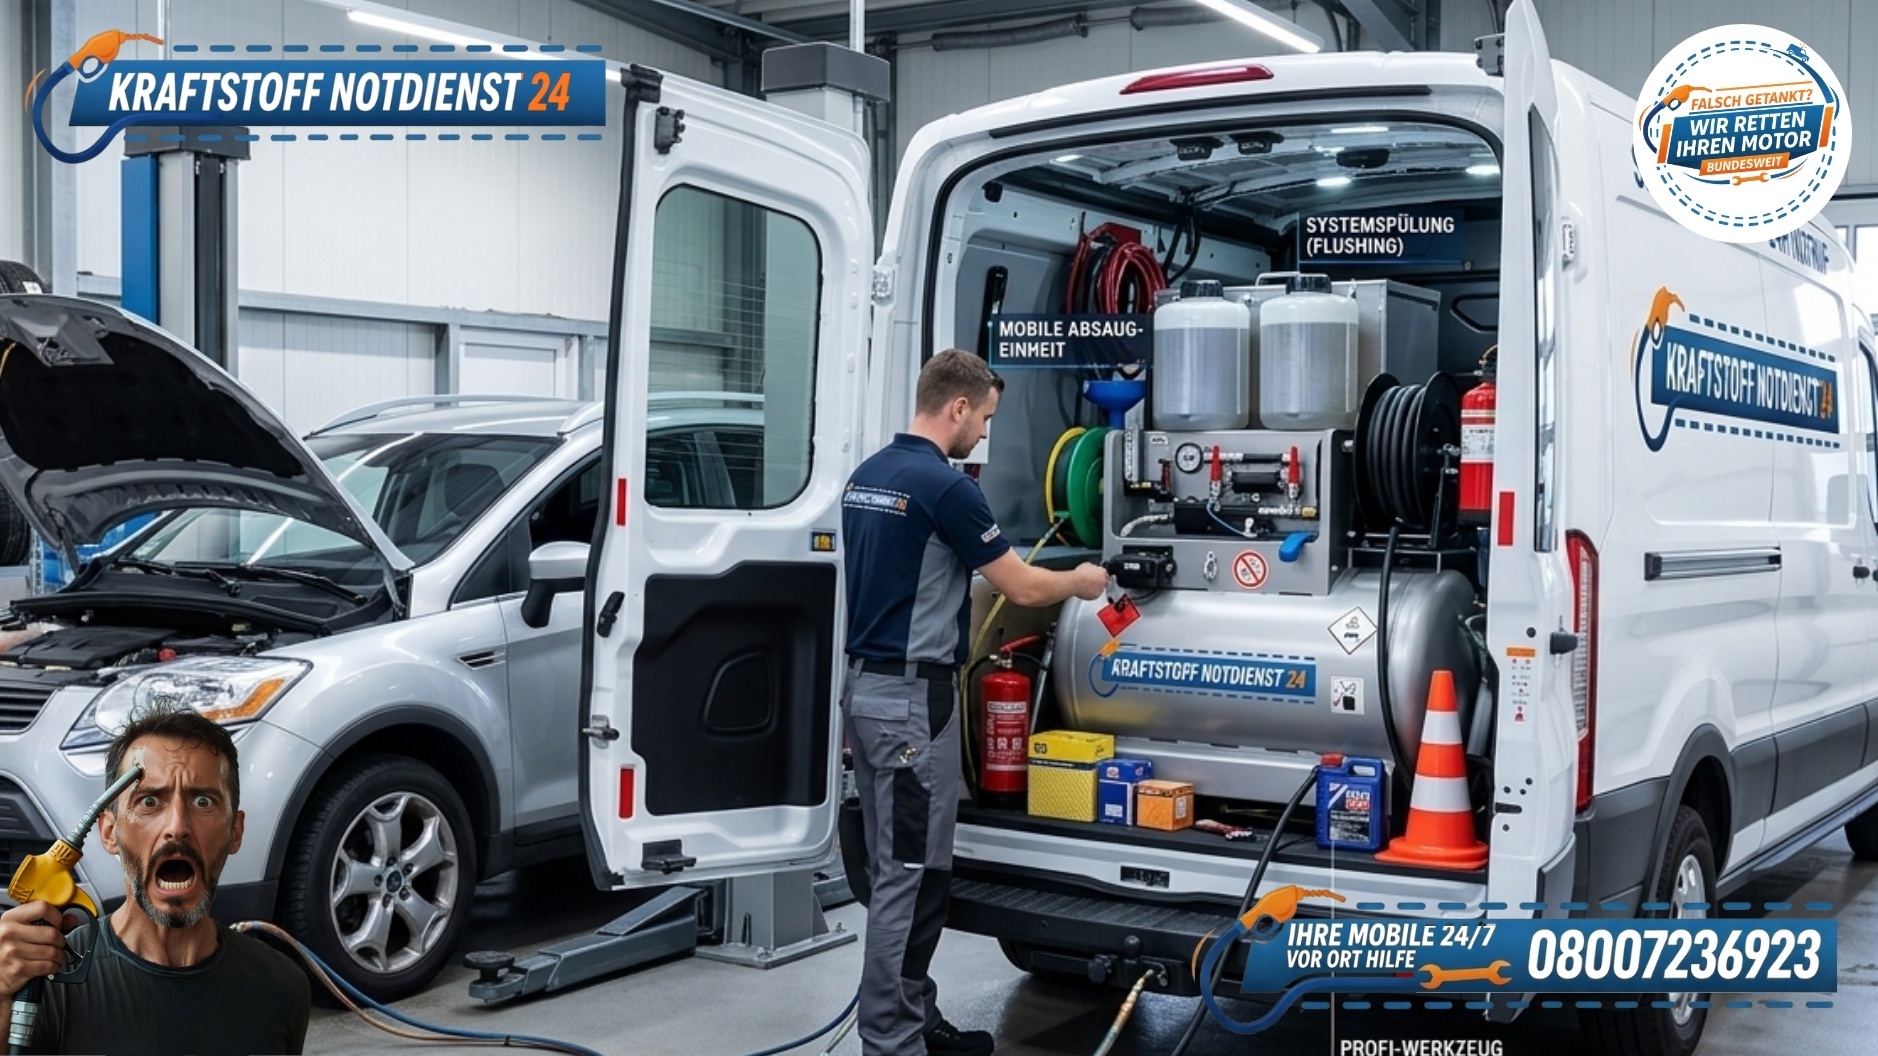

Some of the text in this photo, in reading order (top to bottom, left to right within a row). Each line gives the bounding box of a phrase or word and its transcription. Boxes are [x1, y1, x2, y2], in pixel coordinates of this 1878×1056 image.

[1666, 341, 1756, 405] KRAFTSTOFF
[1200, 663, 1285, 687] NOTDIENST
[1285, 669, 1306, 689] 24
